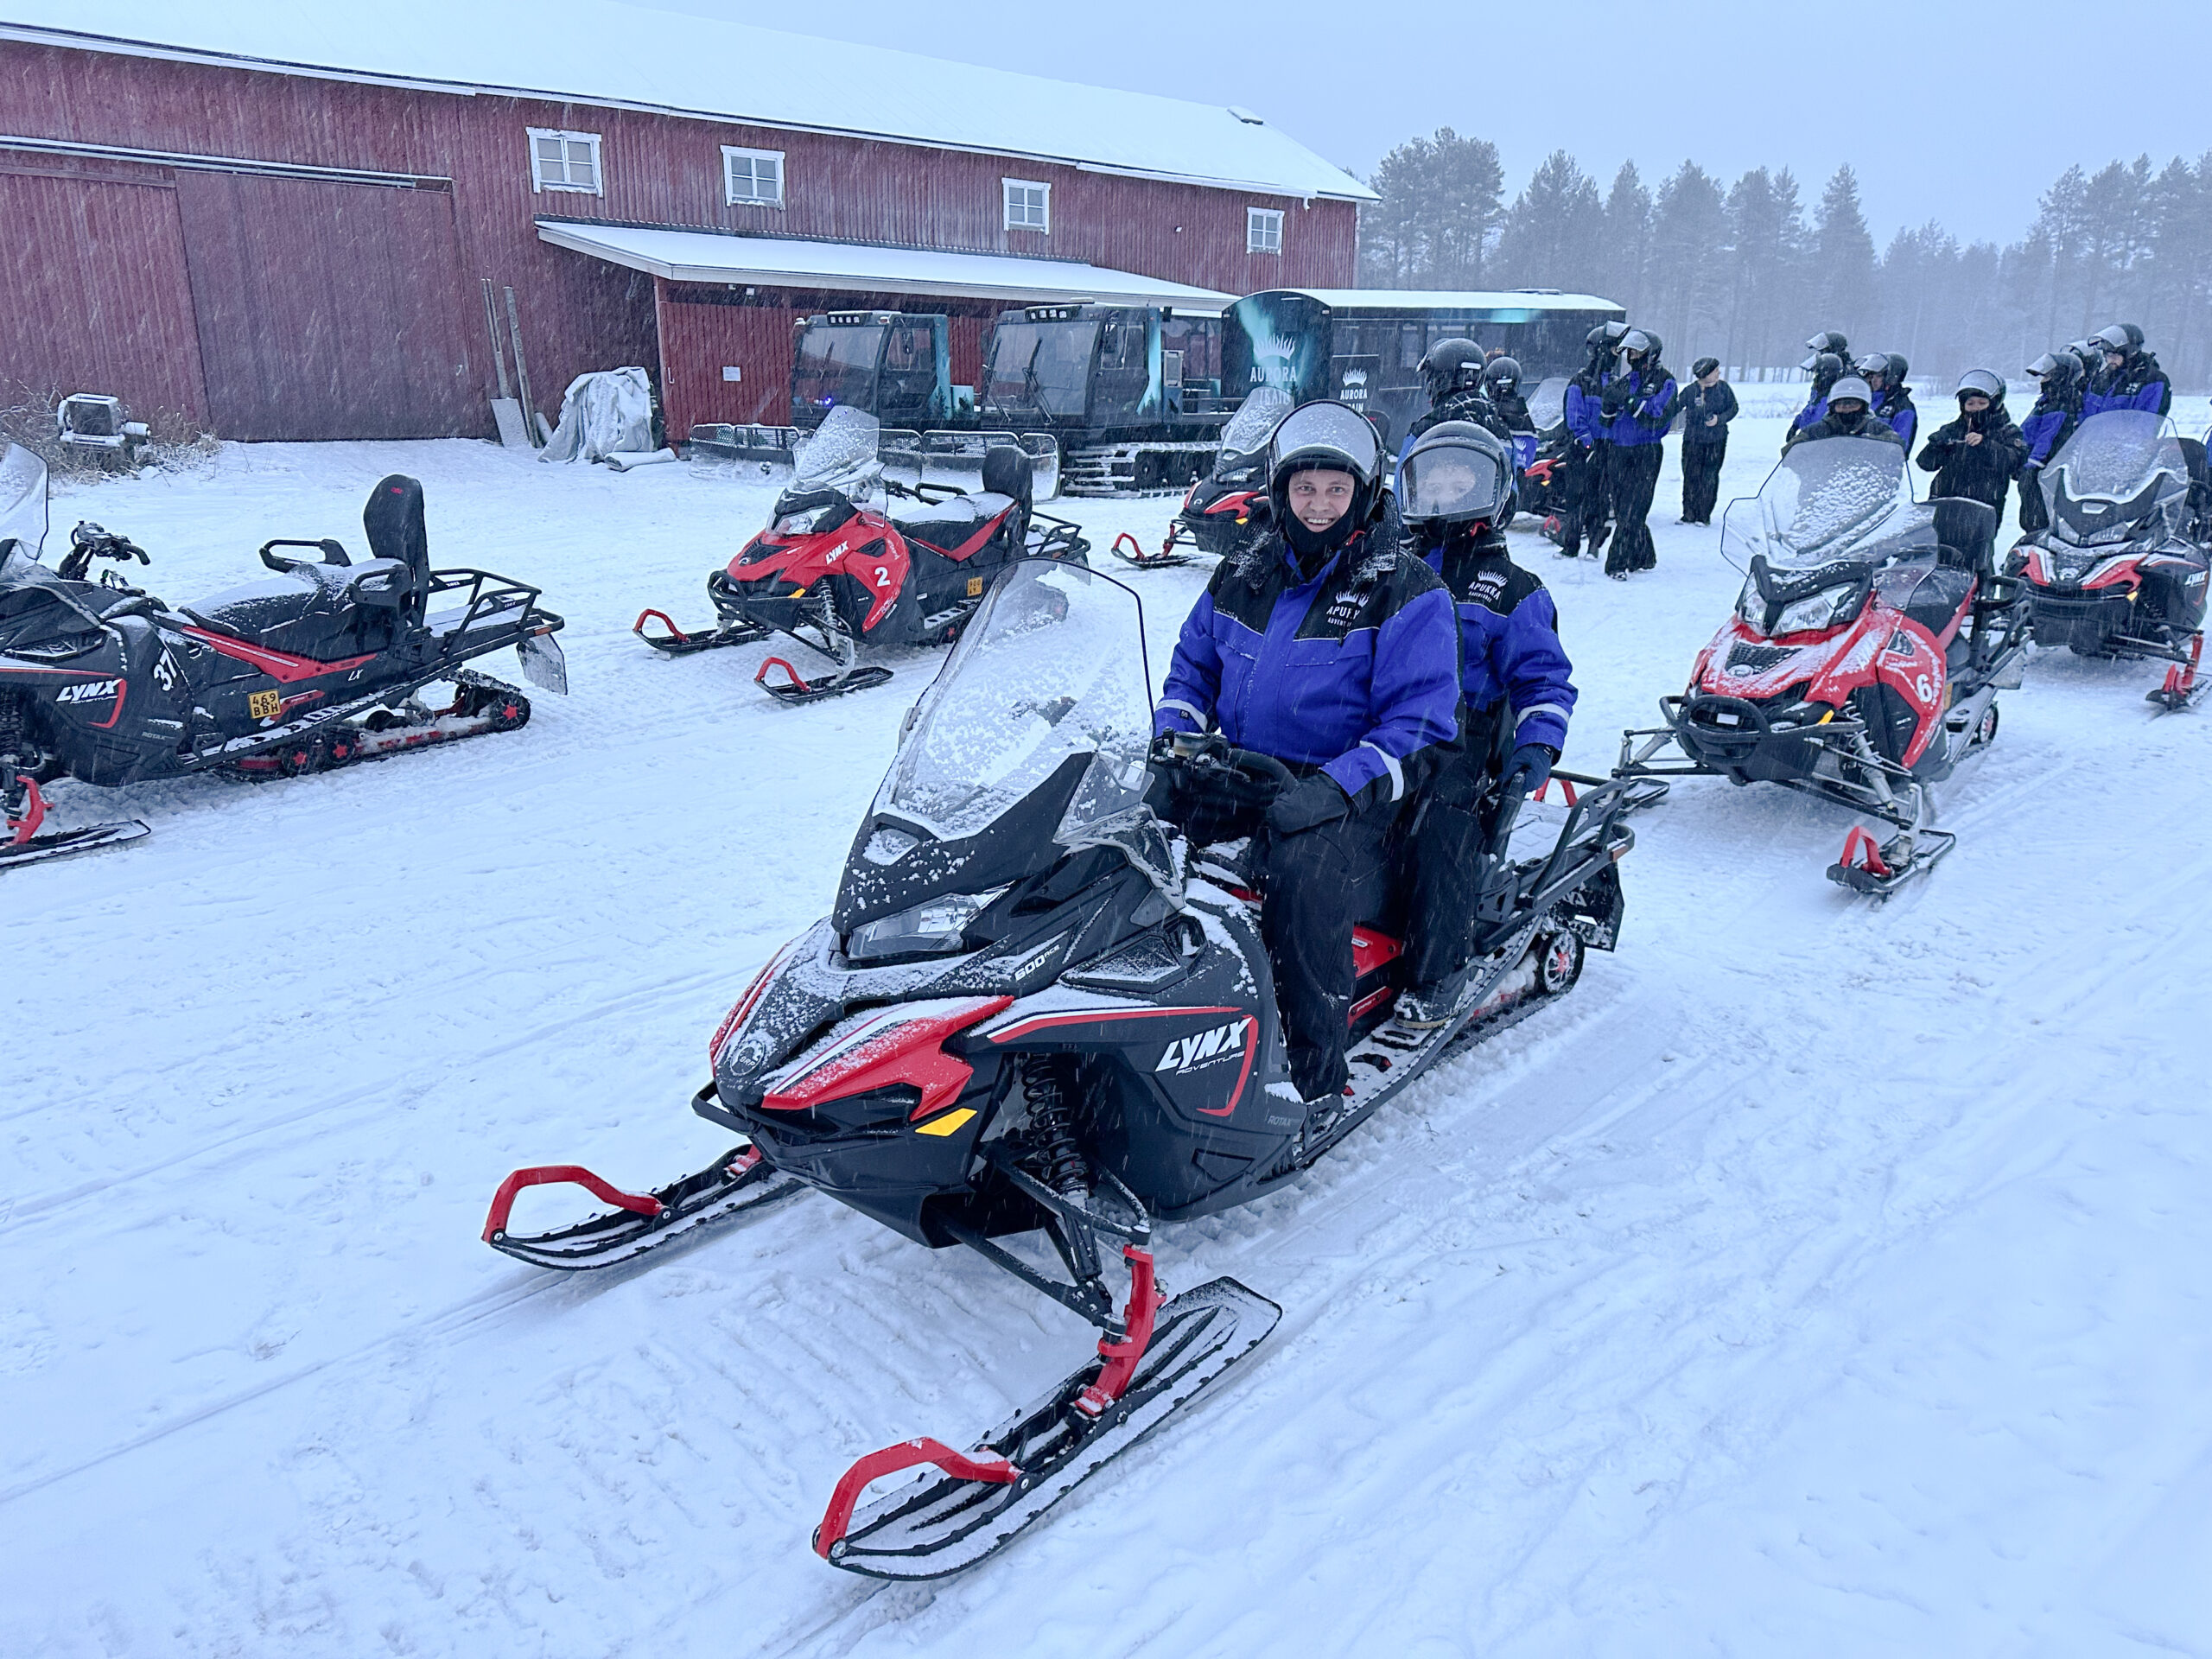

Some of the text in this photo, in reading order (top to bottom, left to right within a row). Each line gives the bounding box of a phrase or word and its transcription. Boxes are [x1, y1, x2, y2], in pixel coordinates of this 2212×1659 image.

[1249, 366, 1297, 382] AURORA
[1340, 389, 1367, 400] AURORA
[825, 540, 849, 565] LYNX
[874, 567, 891, 587] 2
[1468, 582, 1502, 601] APUKKA
[153, 649, 177, 691] 37
[347, 669, 363, 682] LX
[55, 678, 123, 702] LYNX
[252, 692, 277, 705] 469
[1916, 674, 1934, 702] 6
[253, 702, 279, 716] BBH
[1014, 944, 1060, 981] 600 ACE
[1155, 1016, 1253, 1071] LYNX
[1176, 1050, 1246, 1076] ADVENTURE
